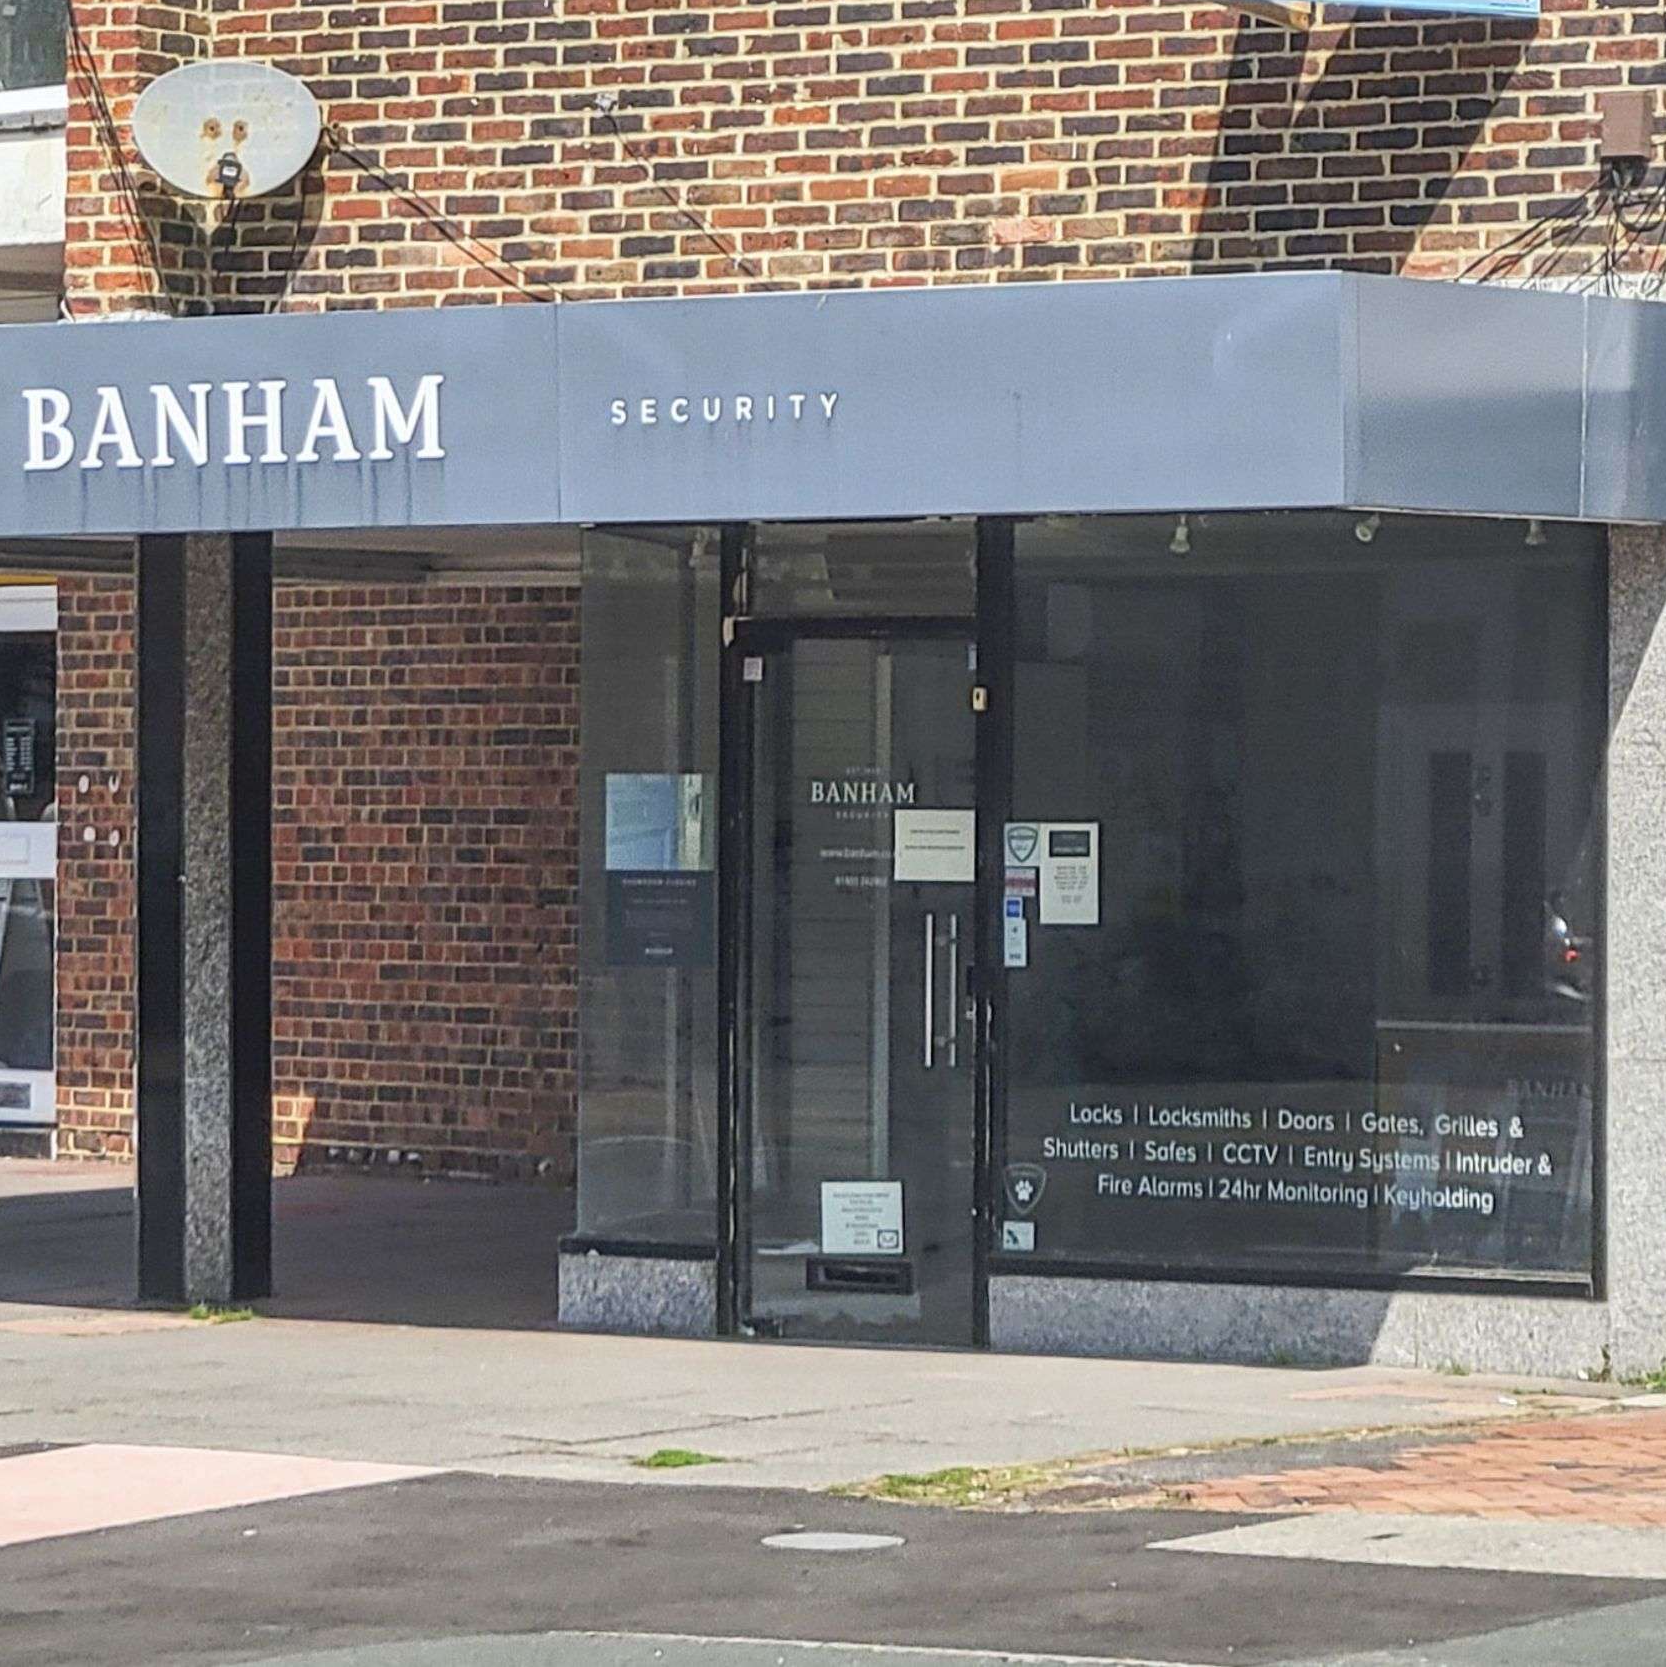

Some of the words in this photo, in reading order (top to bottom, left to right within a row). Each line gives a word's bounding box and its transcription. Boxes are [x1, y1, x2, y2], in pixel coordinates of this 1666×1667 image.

[22, 373, 447, 474] BANHAM
[609, 390, 843, 427] SECURITY
[811, 781, 916, 804] BANHAM
[1069, 1103, 1123, 1126] Locks
[1148, 1106, 1251, 1130] Locksmiths
[1278, 1109, 1334, 1132] Doors
[1434, 1114, 1499, 1138] Grilles
[1509, 1116, 1524, 1138] &
[1043, 1137, 1119, 1161] Shutters
[1144, 1140, 1197, 1163] Safes
[1222, 1143, 1279, 1166] CCTV
[1303, 1145, 1354, 1171] Entry
[1359, 1148, 1440, 1173] Systems
[1456, 1150, 1533, 1175] Intruder
[1538, 1154, 1552, 1175] &
[1097, 1174, 1133, 1196] Fire
[1137, 1175, 1203, 1199] Alarms
[1218, 1177, 1262, 1201] 24hr
[1267, 1179, 1369, 1208] Monitoring
[1383, 1185, 1495, 1214] Keyholding
